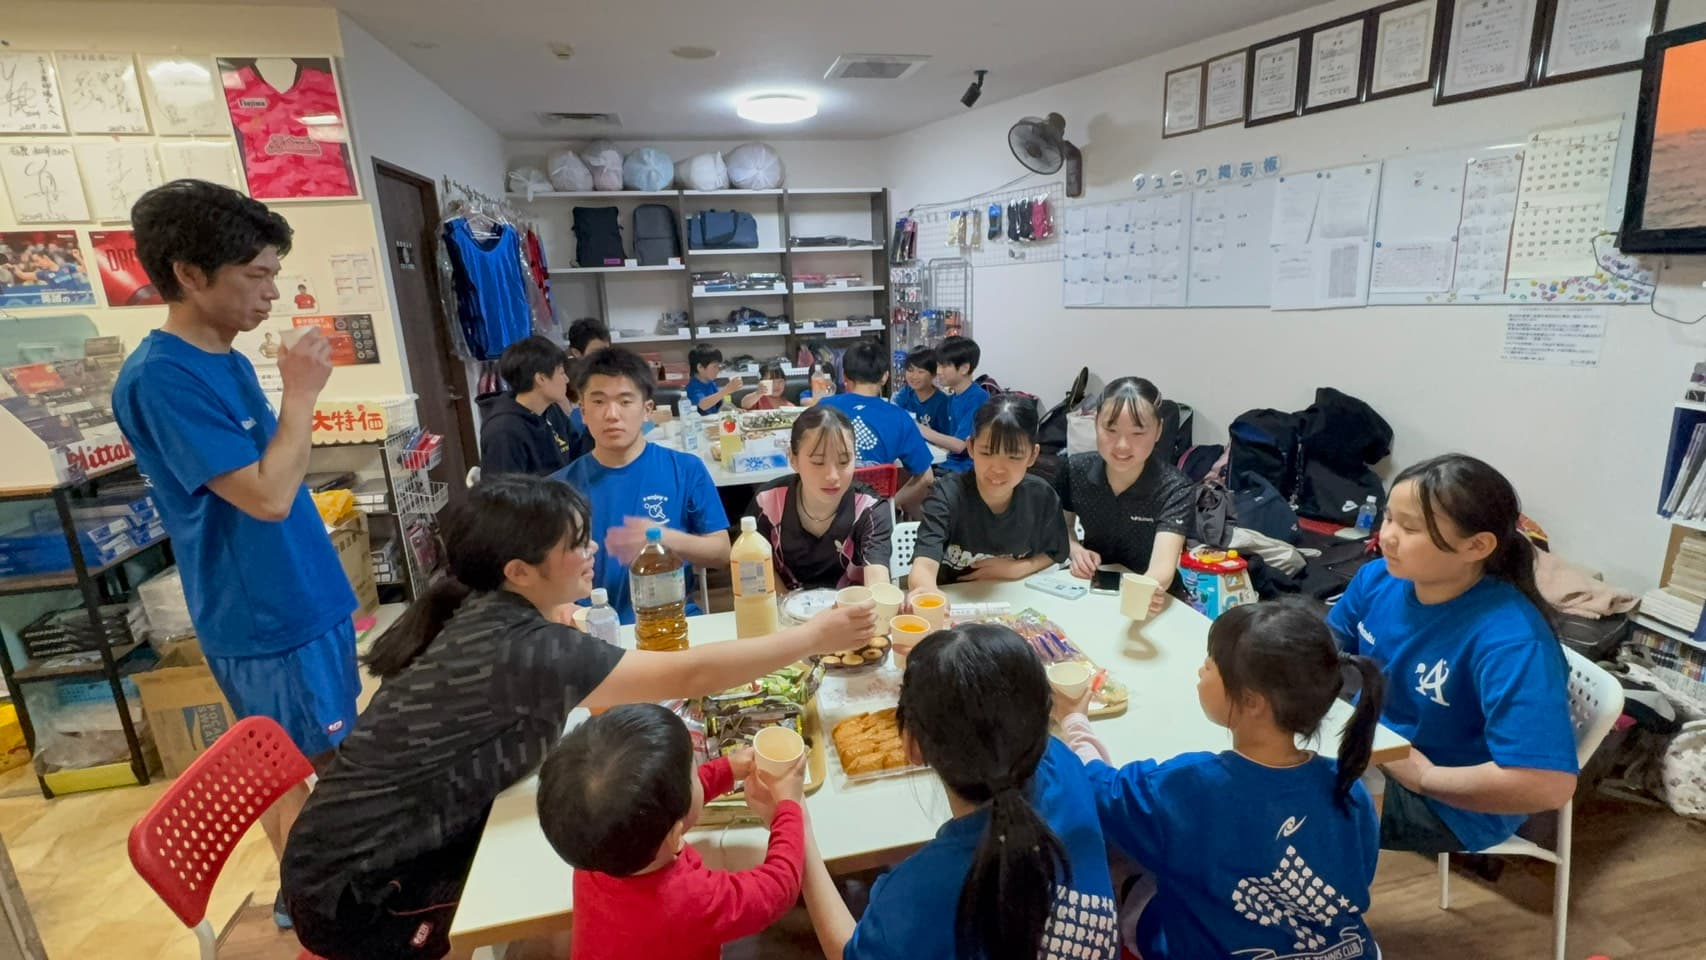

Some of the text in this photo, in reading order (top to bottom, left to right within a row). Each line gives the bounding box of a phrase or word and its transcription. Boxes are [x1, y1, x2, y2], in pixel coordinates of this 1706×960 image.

[311, 408, 384, 432] 大特価
[66, 436, 134, 470] Nittak
[1342, 942, 1361, 957] CLUB
